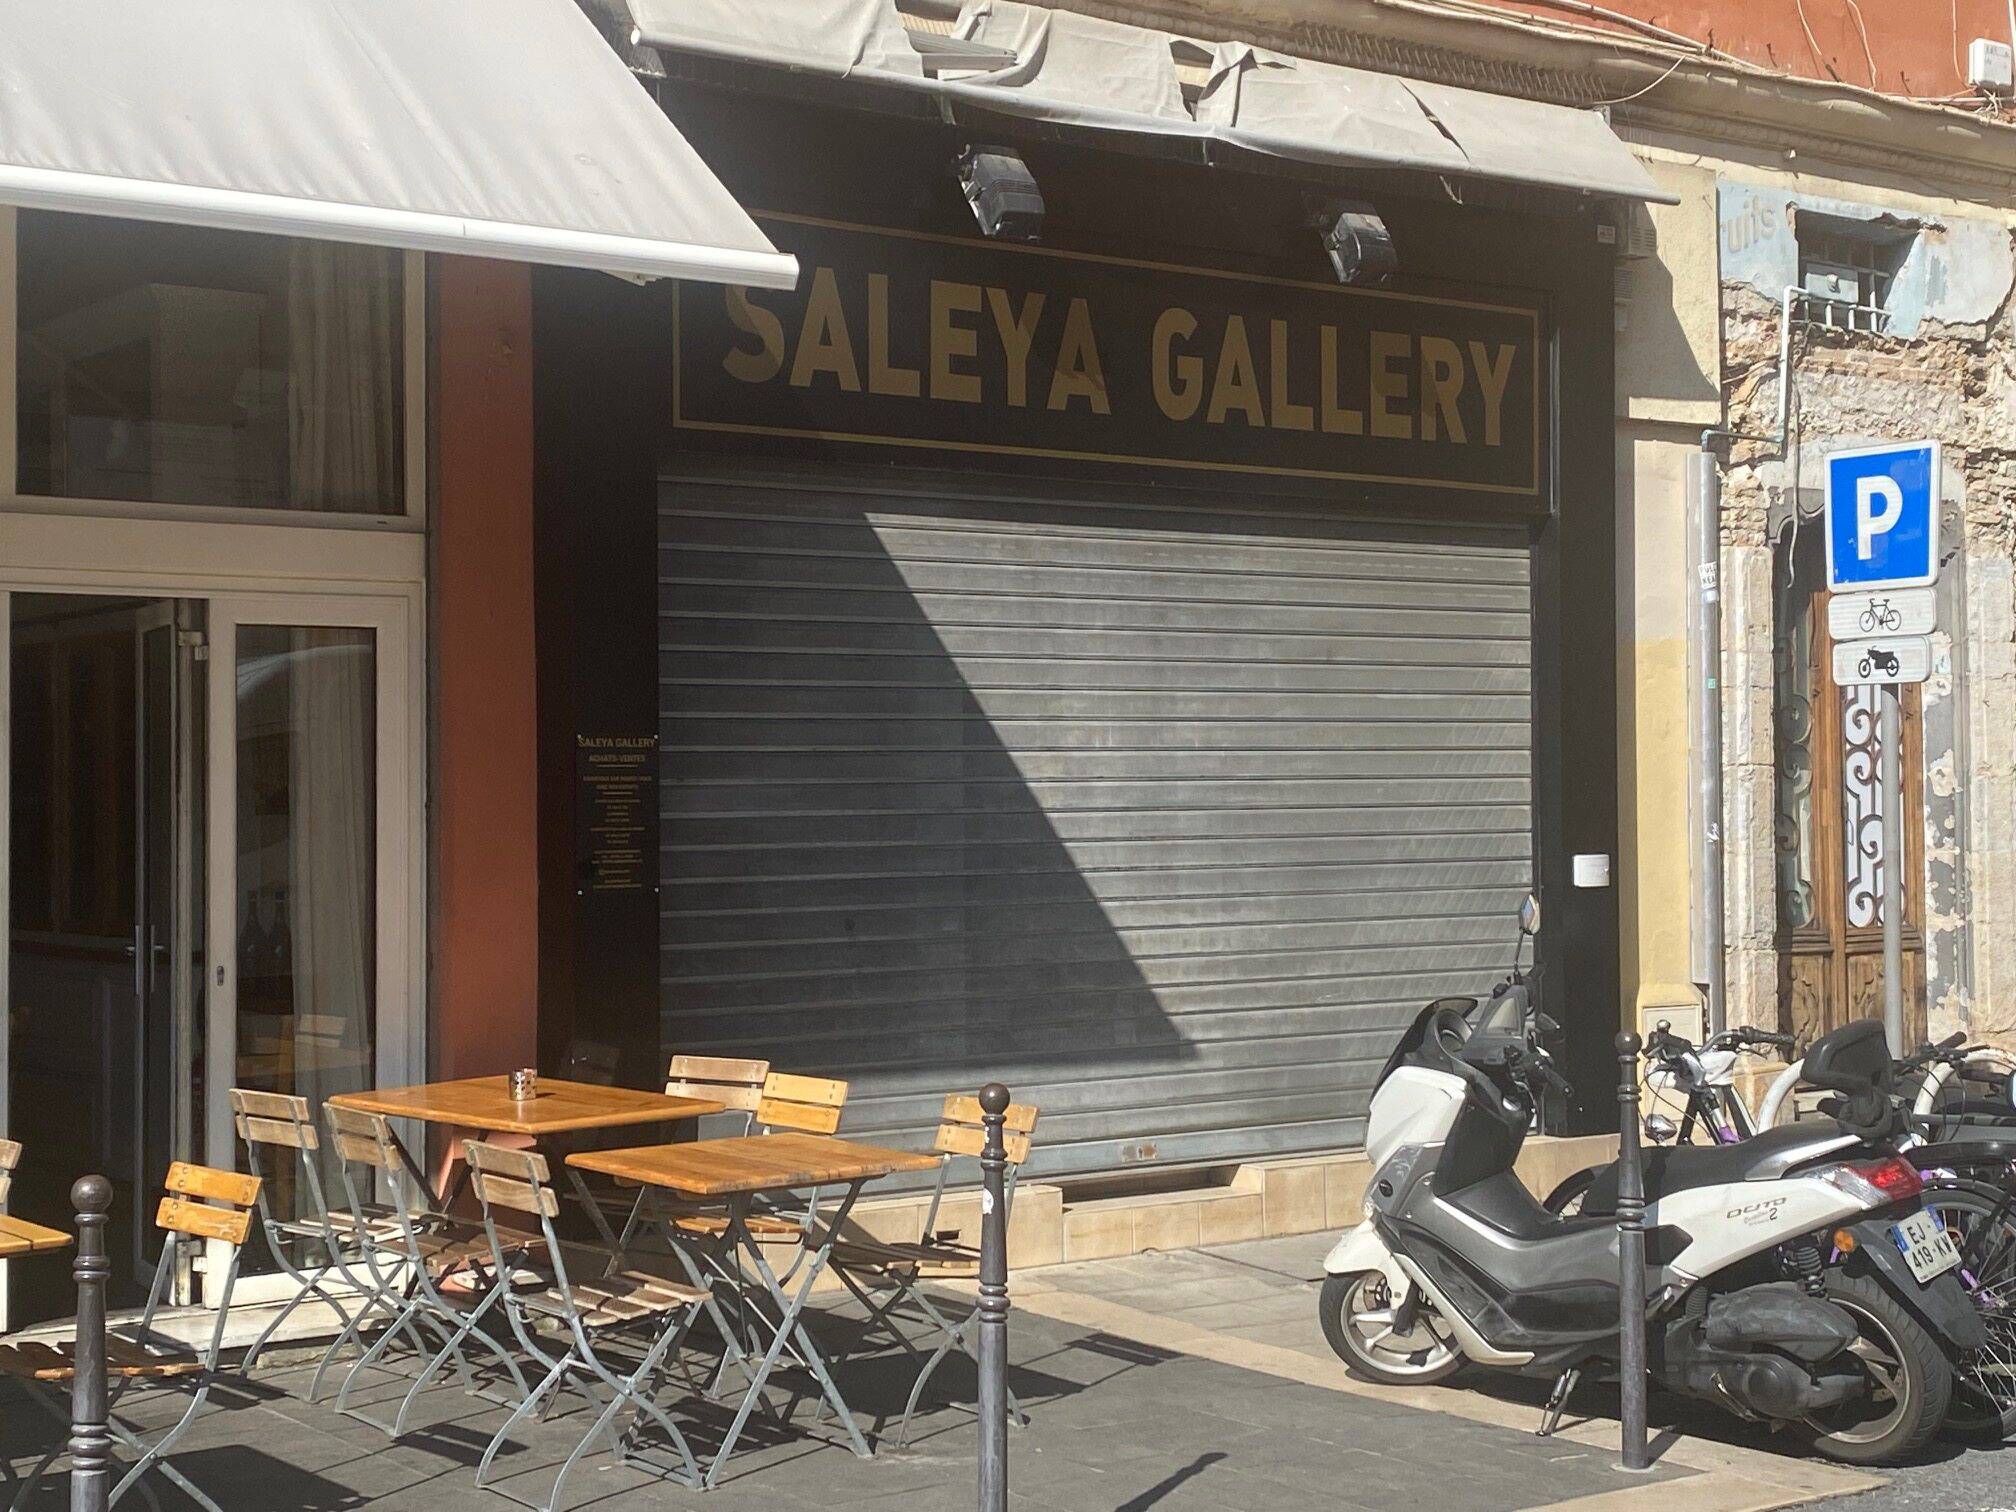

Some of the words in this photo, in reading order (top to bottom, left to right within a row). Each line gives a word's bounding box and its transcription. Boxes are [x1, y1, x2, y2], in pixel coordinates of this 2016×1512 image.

[722, 266, 1111, 415] SALEYA
[1152, 308, 1517, 447] GALLERY
[1857, 474, 1903, 560] P
[578, 737, 613, 748] SALEYA
[615, 737, 655, 748] GALLERY
